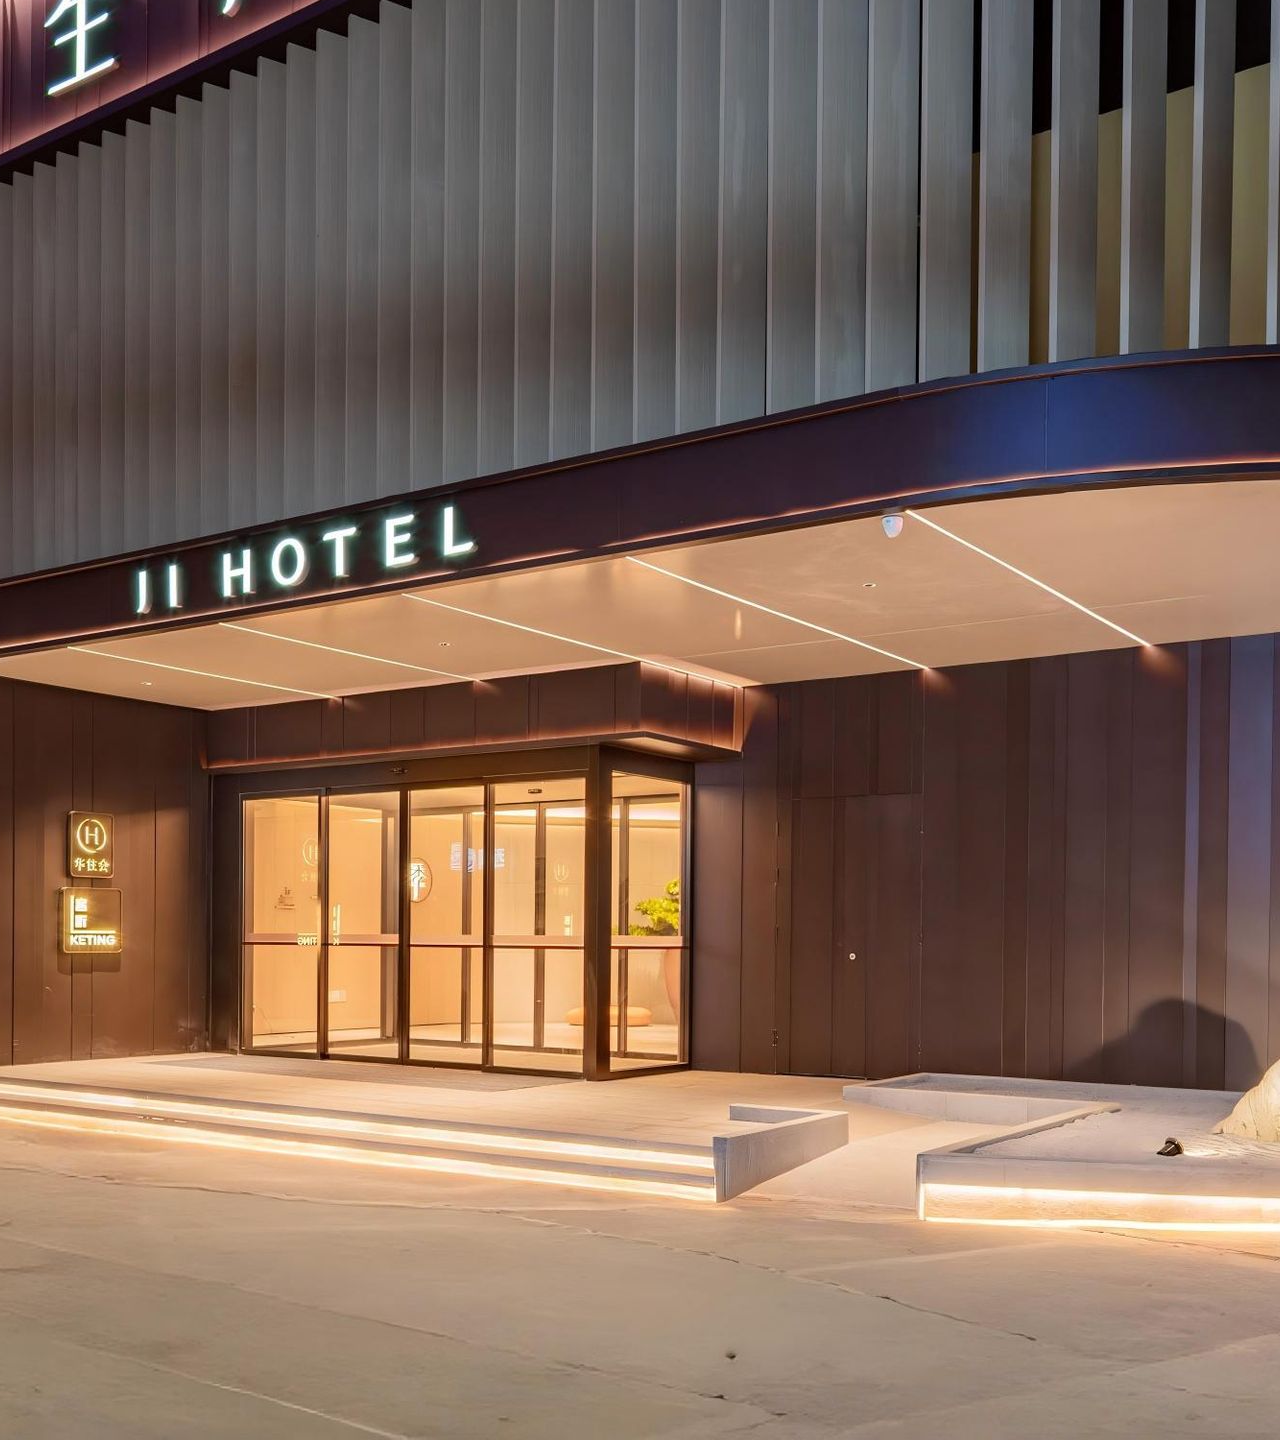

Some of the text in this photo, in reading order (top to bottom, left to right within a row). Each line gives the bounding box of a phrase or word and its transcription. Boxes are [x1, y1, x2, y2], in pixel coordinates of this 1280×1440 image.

[136, 506, 477, 614] JI HOTEL
[69, 934, 116, 946] KETING
